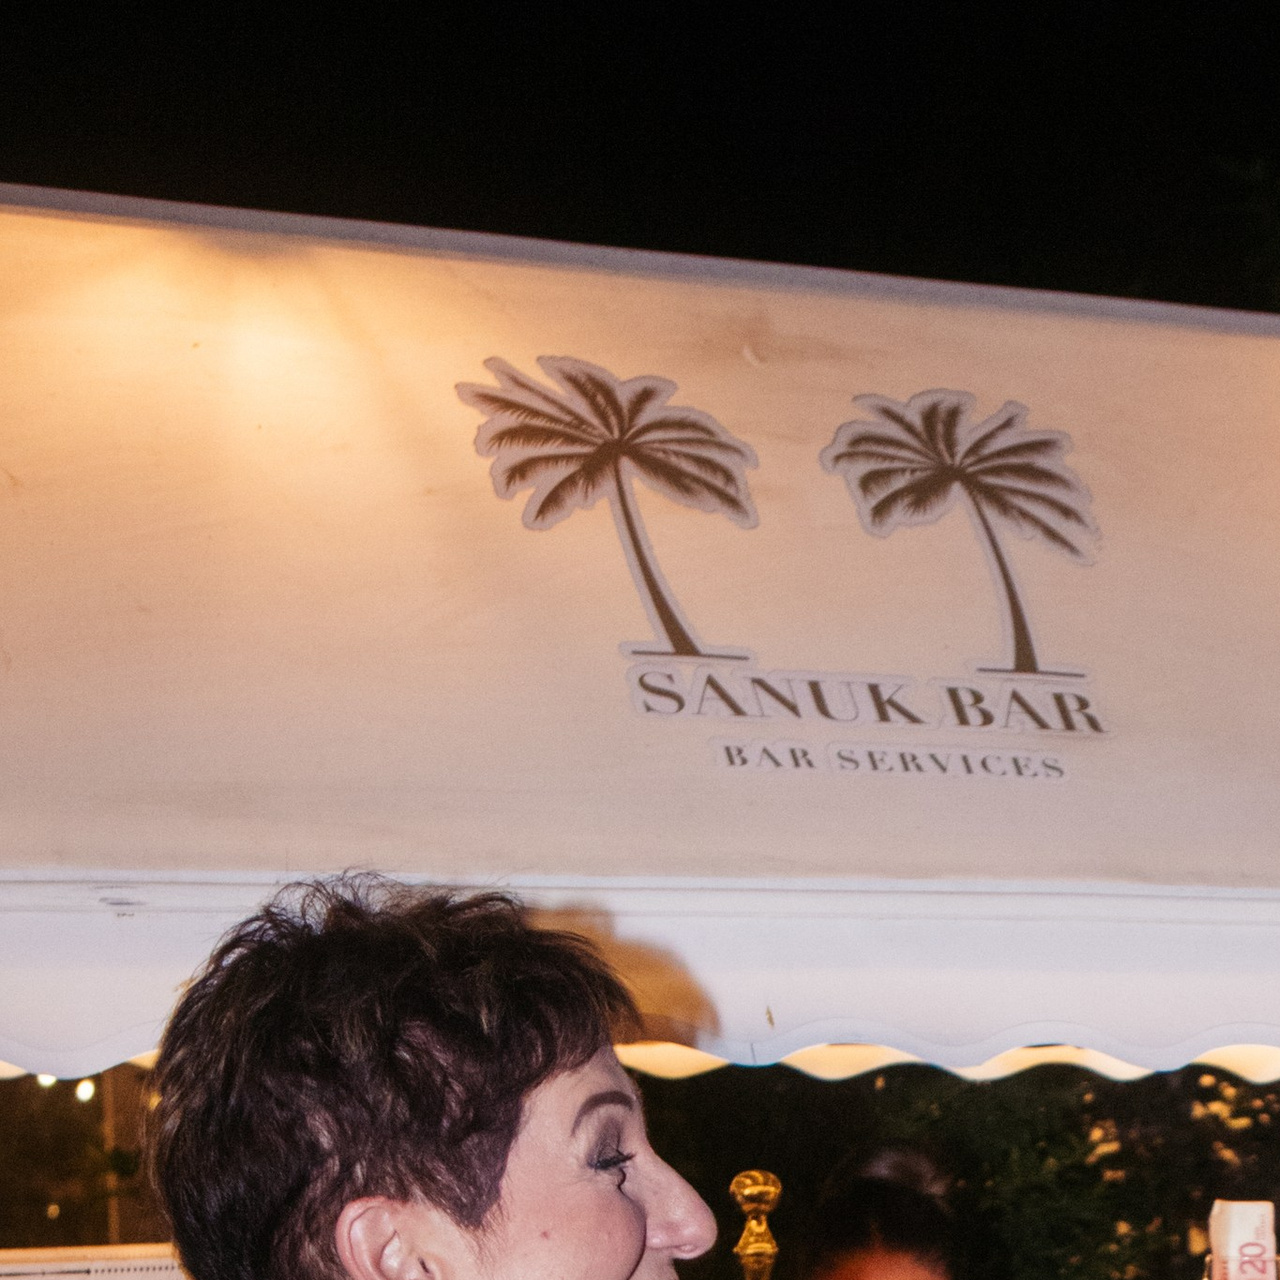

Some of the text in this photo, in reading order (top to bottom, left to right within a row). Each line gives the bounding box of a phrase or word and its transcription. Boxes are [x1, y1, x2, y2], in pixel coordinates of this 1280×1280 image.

[638, 669, 1109, 735] SANUK BAR
[723, 743, 1067, 781] BAR SERVICES
[1238, 1241, 1268, 1276] 20
